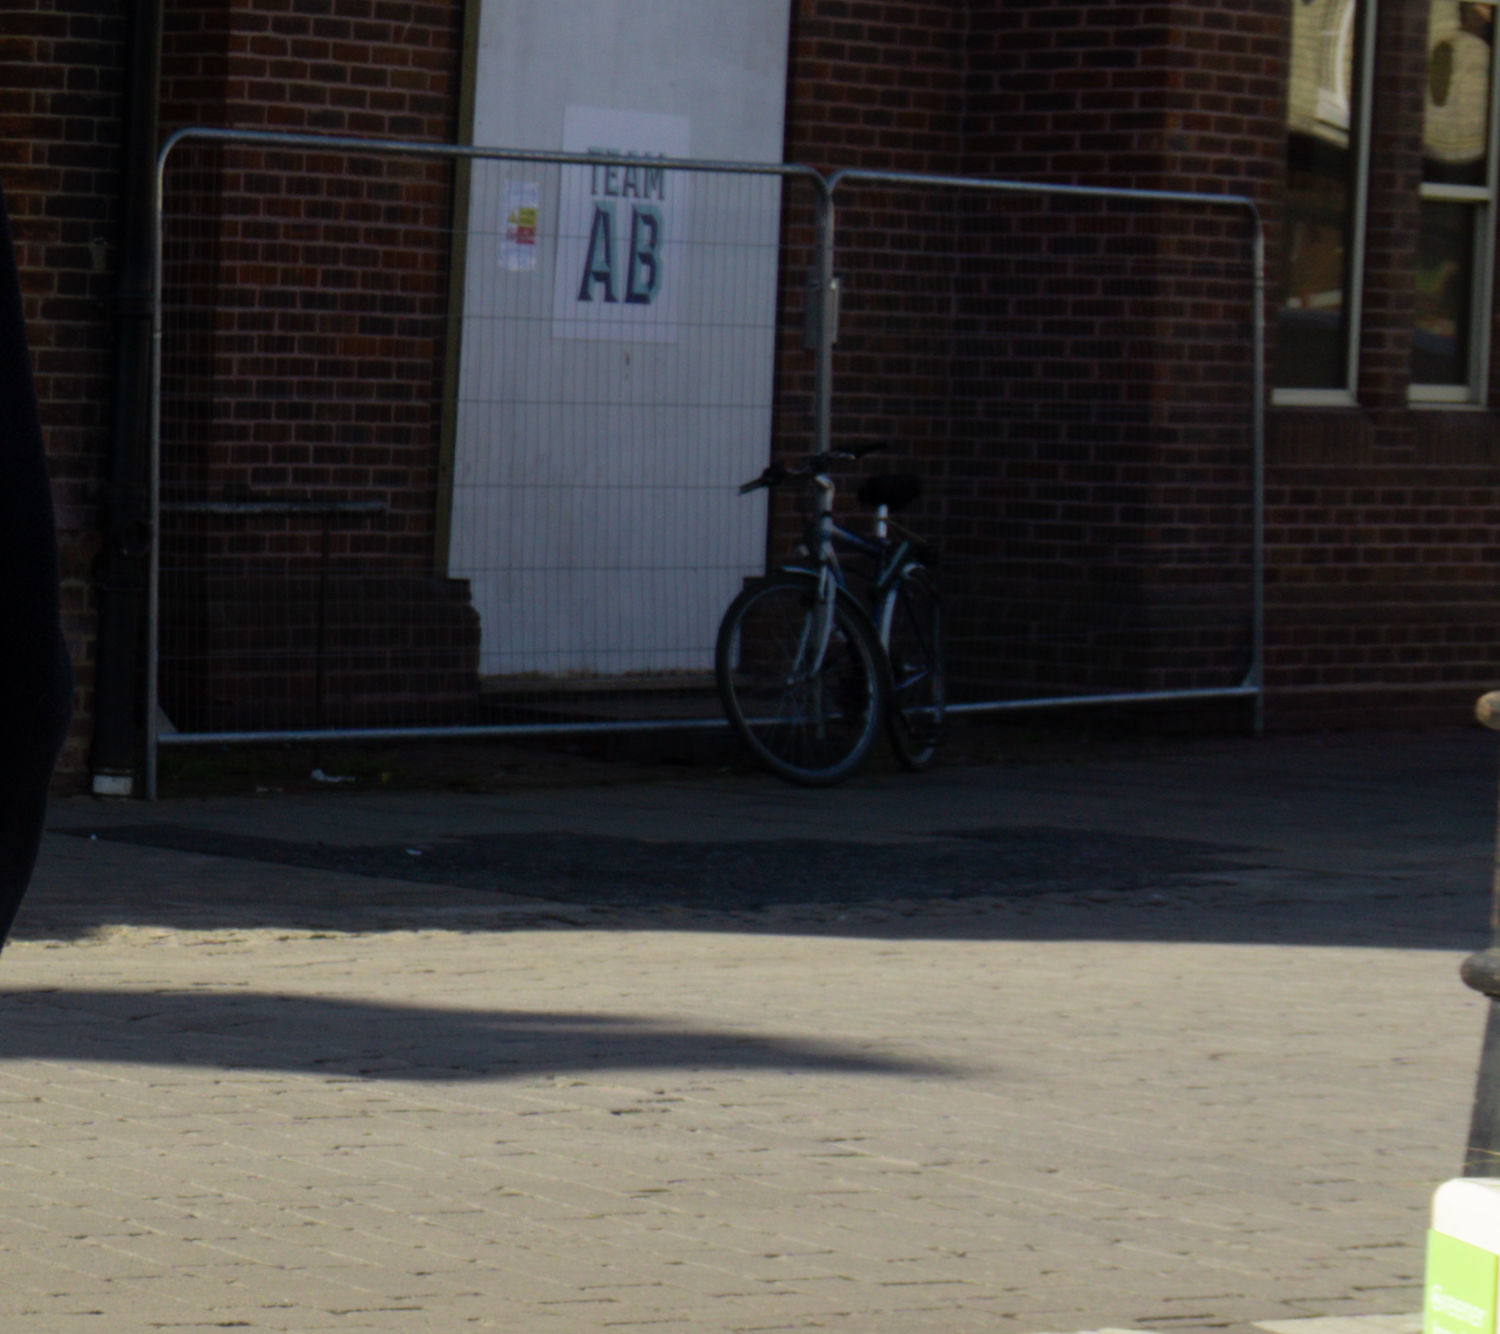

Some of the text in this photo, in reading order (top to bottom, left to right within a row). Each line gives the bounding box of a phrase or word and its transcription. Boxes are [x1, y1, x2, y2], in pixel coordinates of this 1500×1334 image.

[588, 146, 667, 200] TEAM
[577, 199, 665, 305] AB
[1430, 1283, 1488, 1329] Greener
